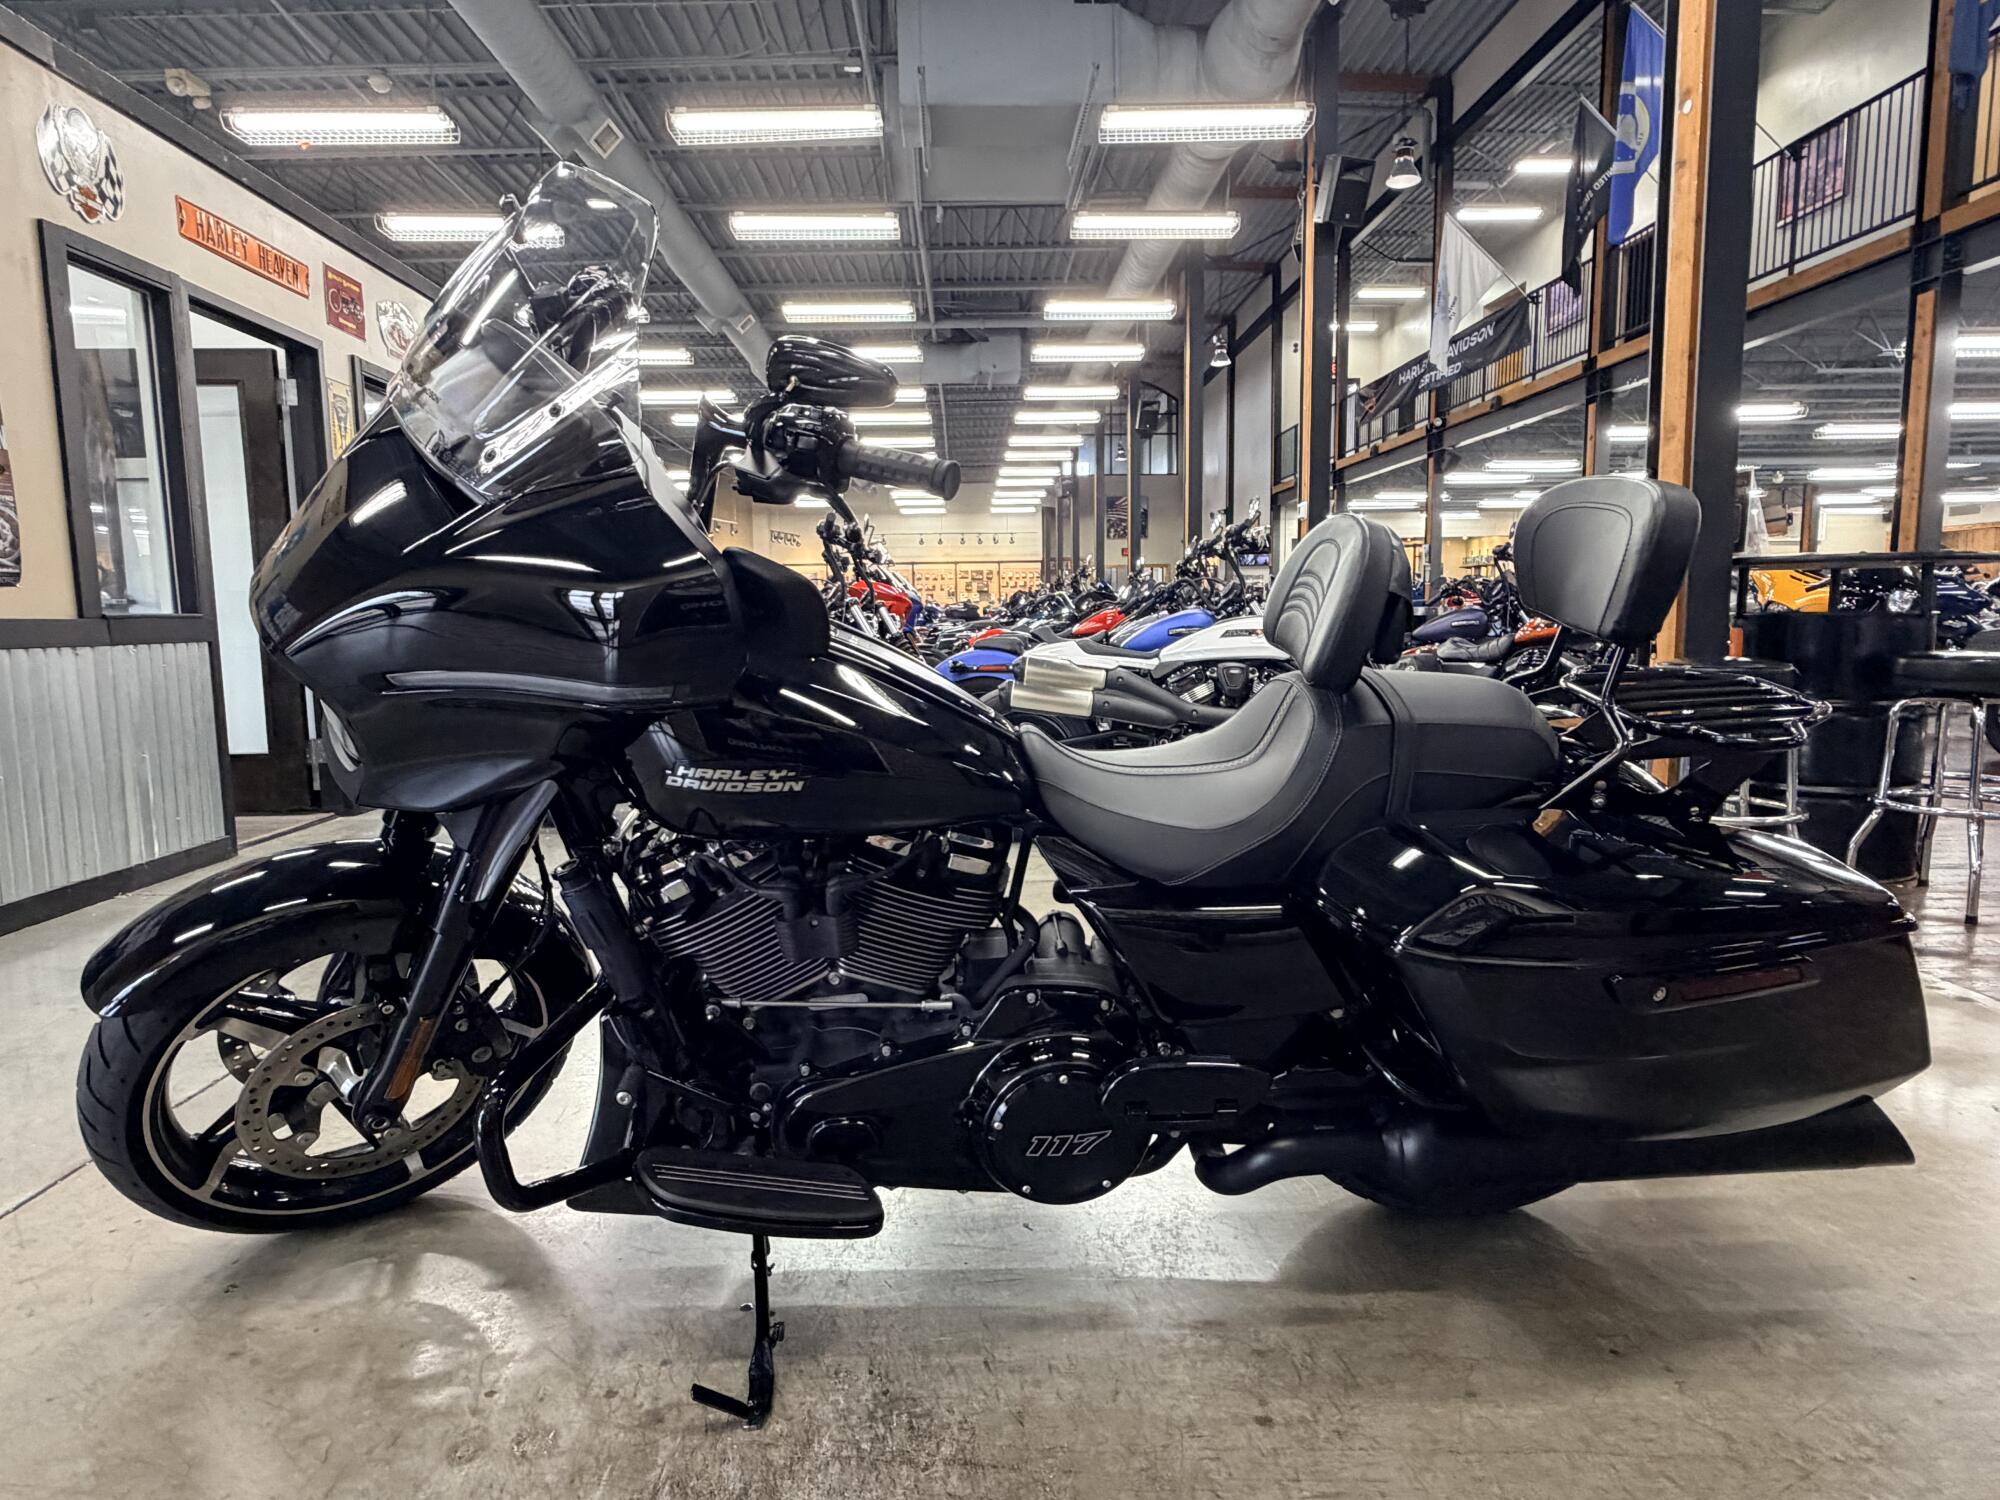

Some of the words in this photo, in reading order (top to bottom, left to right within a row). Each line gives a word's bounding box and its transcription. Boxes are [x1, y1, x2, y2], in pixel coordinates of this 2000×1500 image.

[196, 211, 247, 260] HARLEY
[257, 242, 300, 288] HEAVEN
[665, 776, 804, 792] DAVIDSON
[1026, 1130, 1112, 1156] 117
